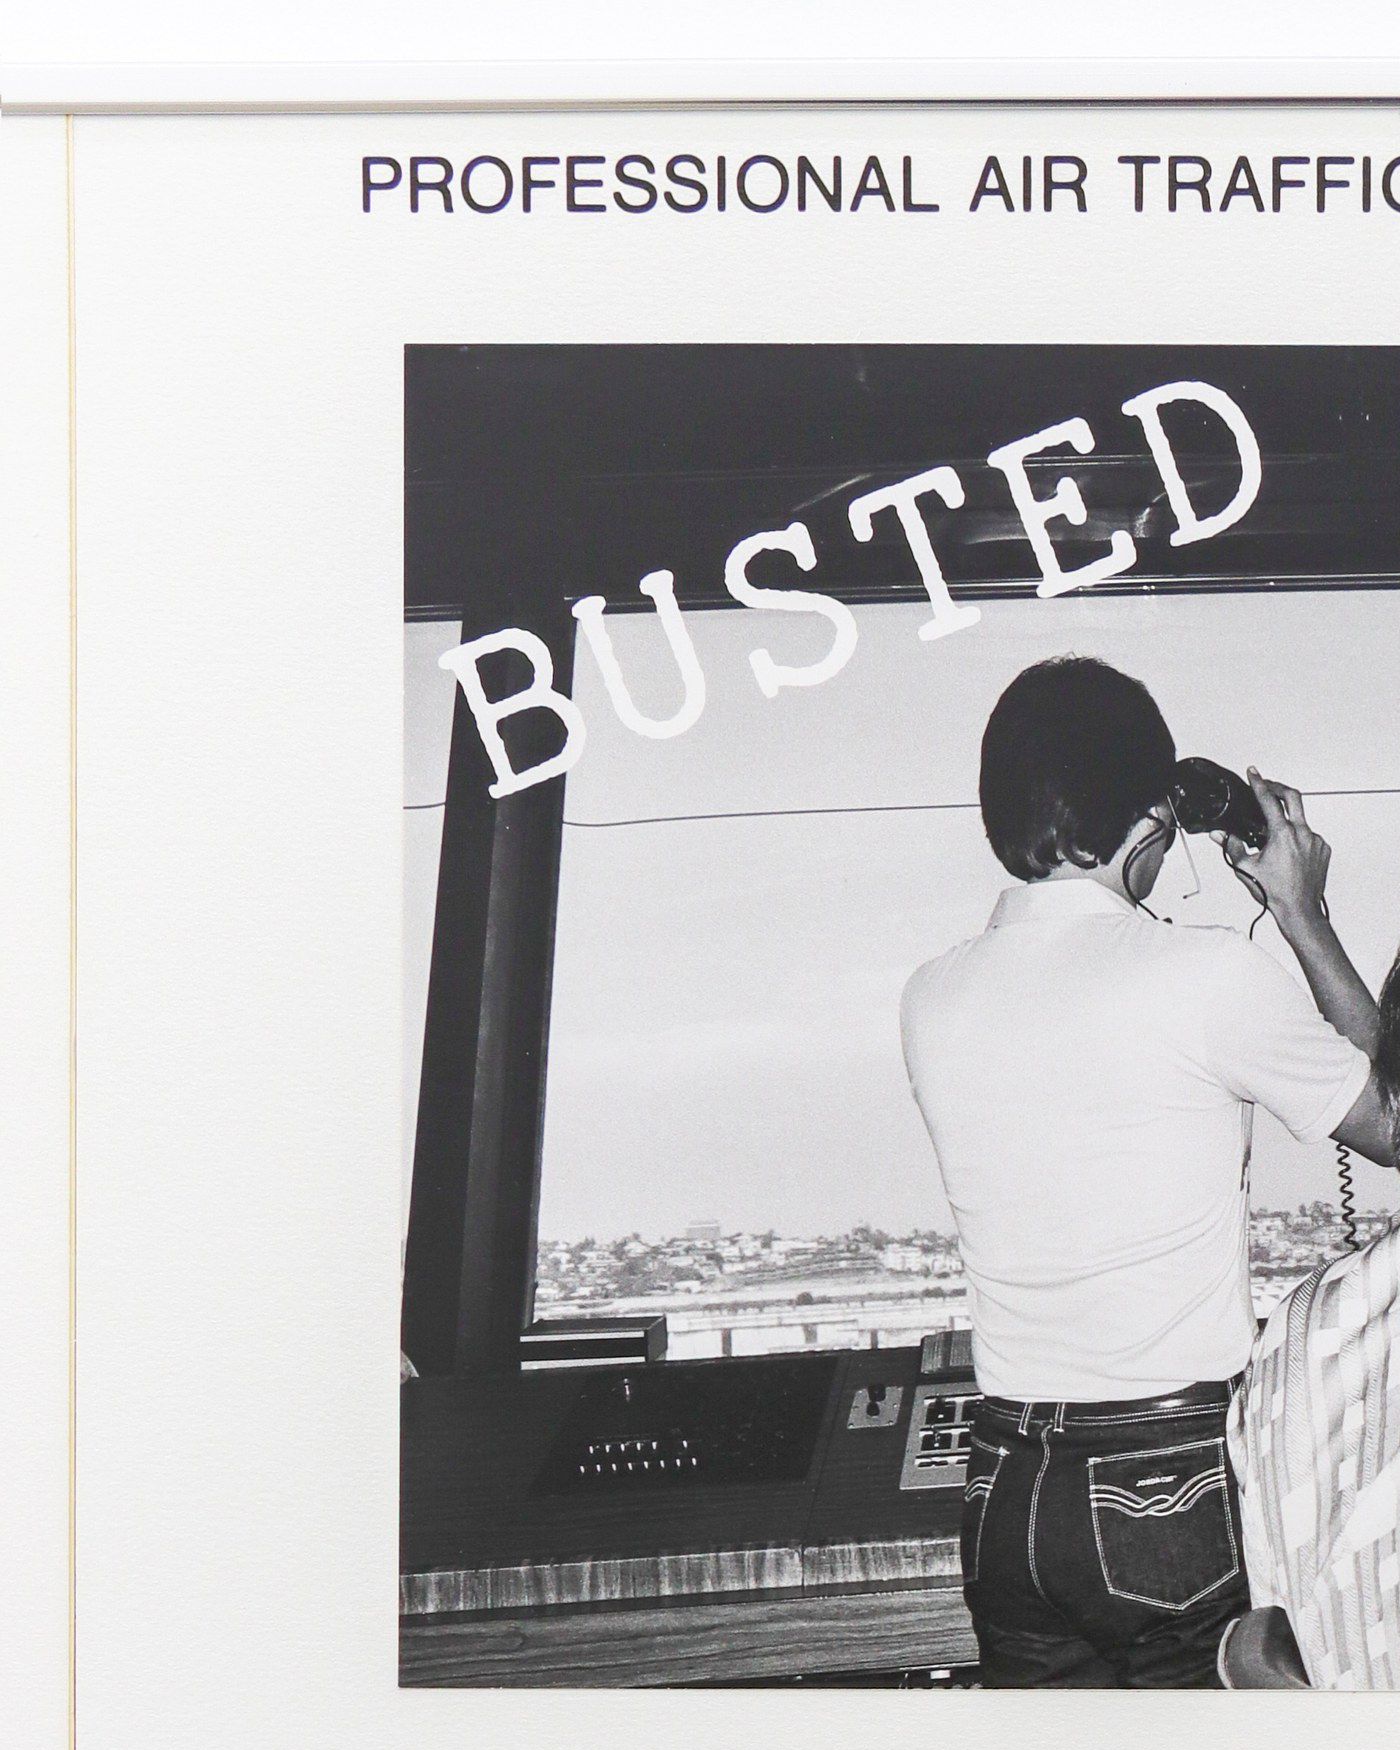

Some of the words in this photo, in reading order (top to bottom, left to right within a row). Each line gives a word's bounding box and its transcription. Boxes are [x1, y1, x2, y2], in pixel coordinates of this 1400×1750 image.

[363, 155, 939, 213] PROFESSIONAL
[970, 156, 1087, 212] AIR
[438, 379, 1263, 798] BUSTED
